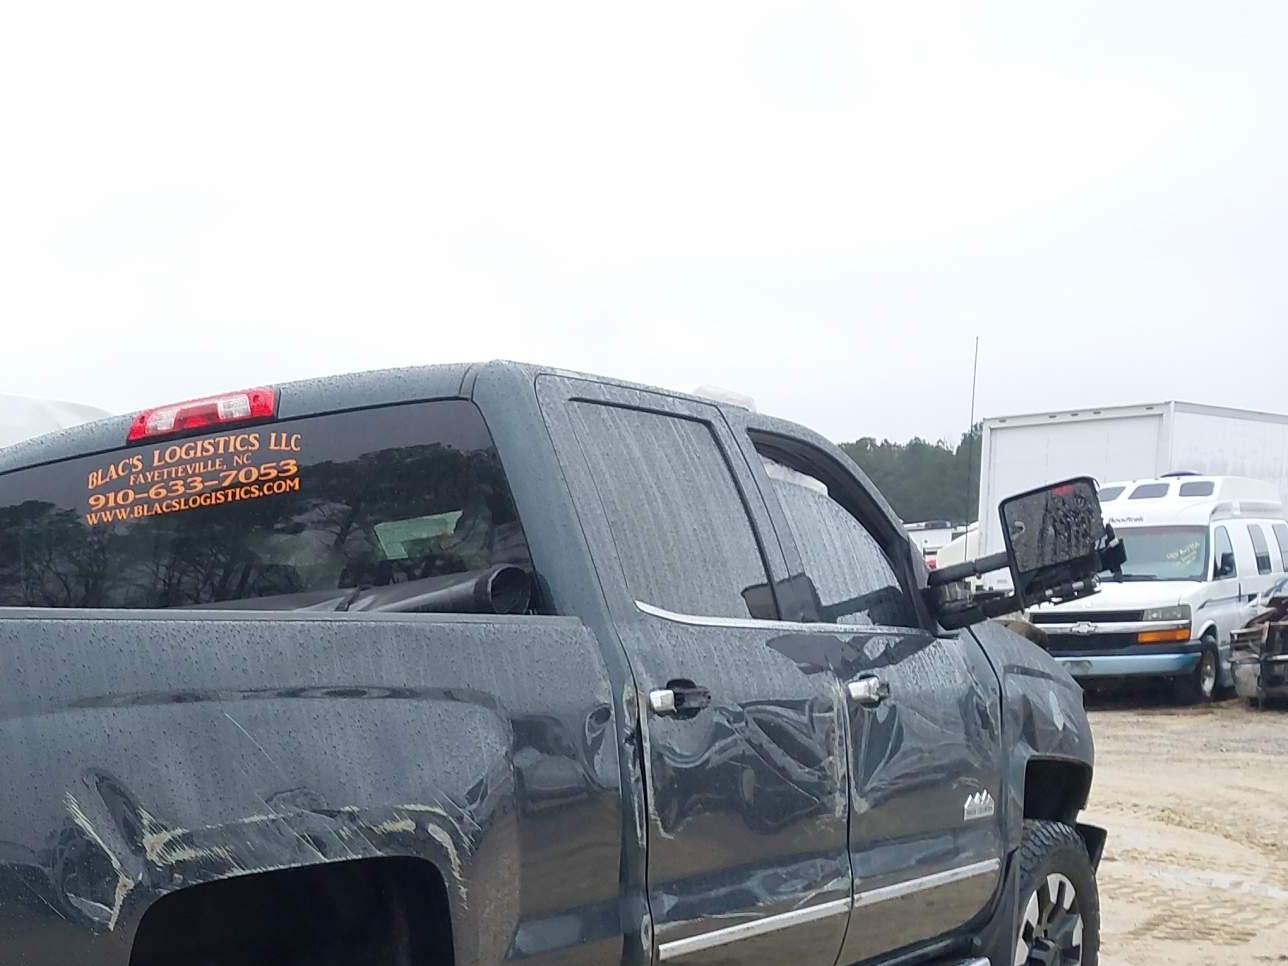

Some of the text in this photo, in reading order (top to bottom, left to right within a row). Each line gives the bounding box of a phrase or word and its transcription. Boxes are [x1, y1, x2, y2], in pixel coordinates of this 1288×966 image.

[88, 432, 302, 489] BLAC'S LOGISTICS LLC
[88, 459, 298, 511] 910-633-7053
[129, 452, 252, 486] FAYETTEVILLE, NC
[86, 477, 300, 525] WWW.BLACSLOGISTICS.COM
